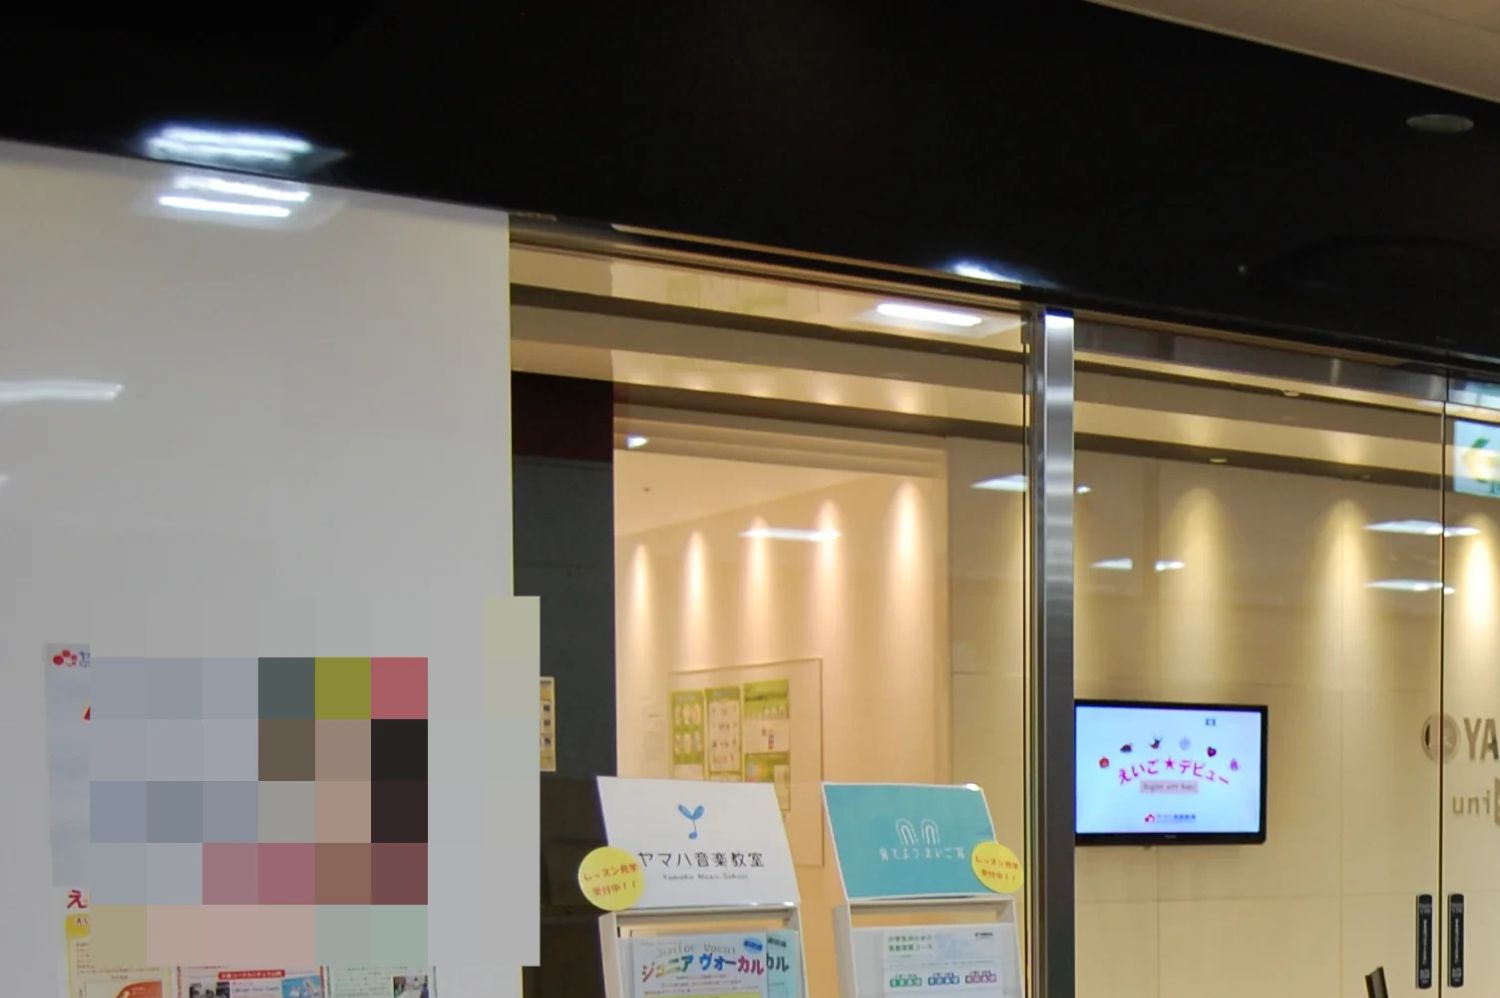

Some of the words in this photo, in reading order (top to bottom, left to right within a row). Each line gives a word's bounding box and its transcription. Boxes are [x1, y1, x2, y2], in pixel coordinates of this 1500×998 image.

[638, 851, 765, 868] ヤマハ音楽教室
[699, 952, 765, 976] ヴォーカル
